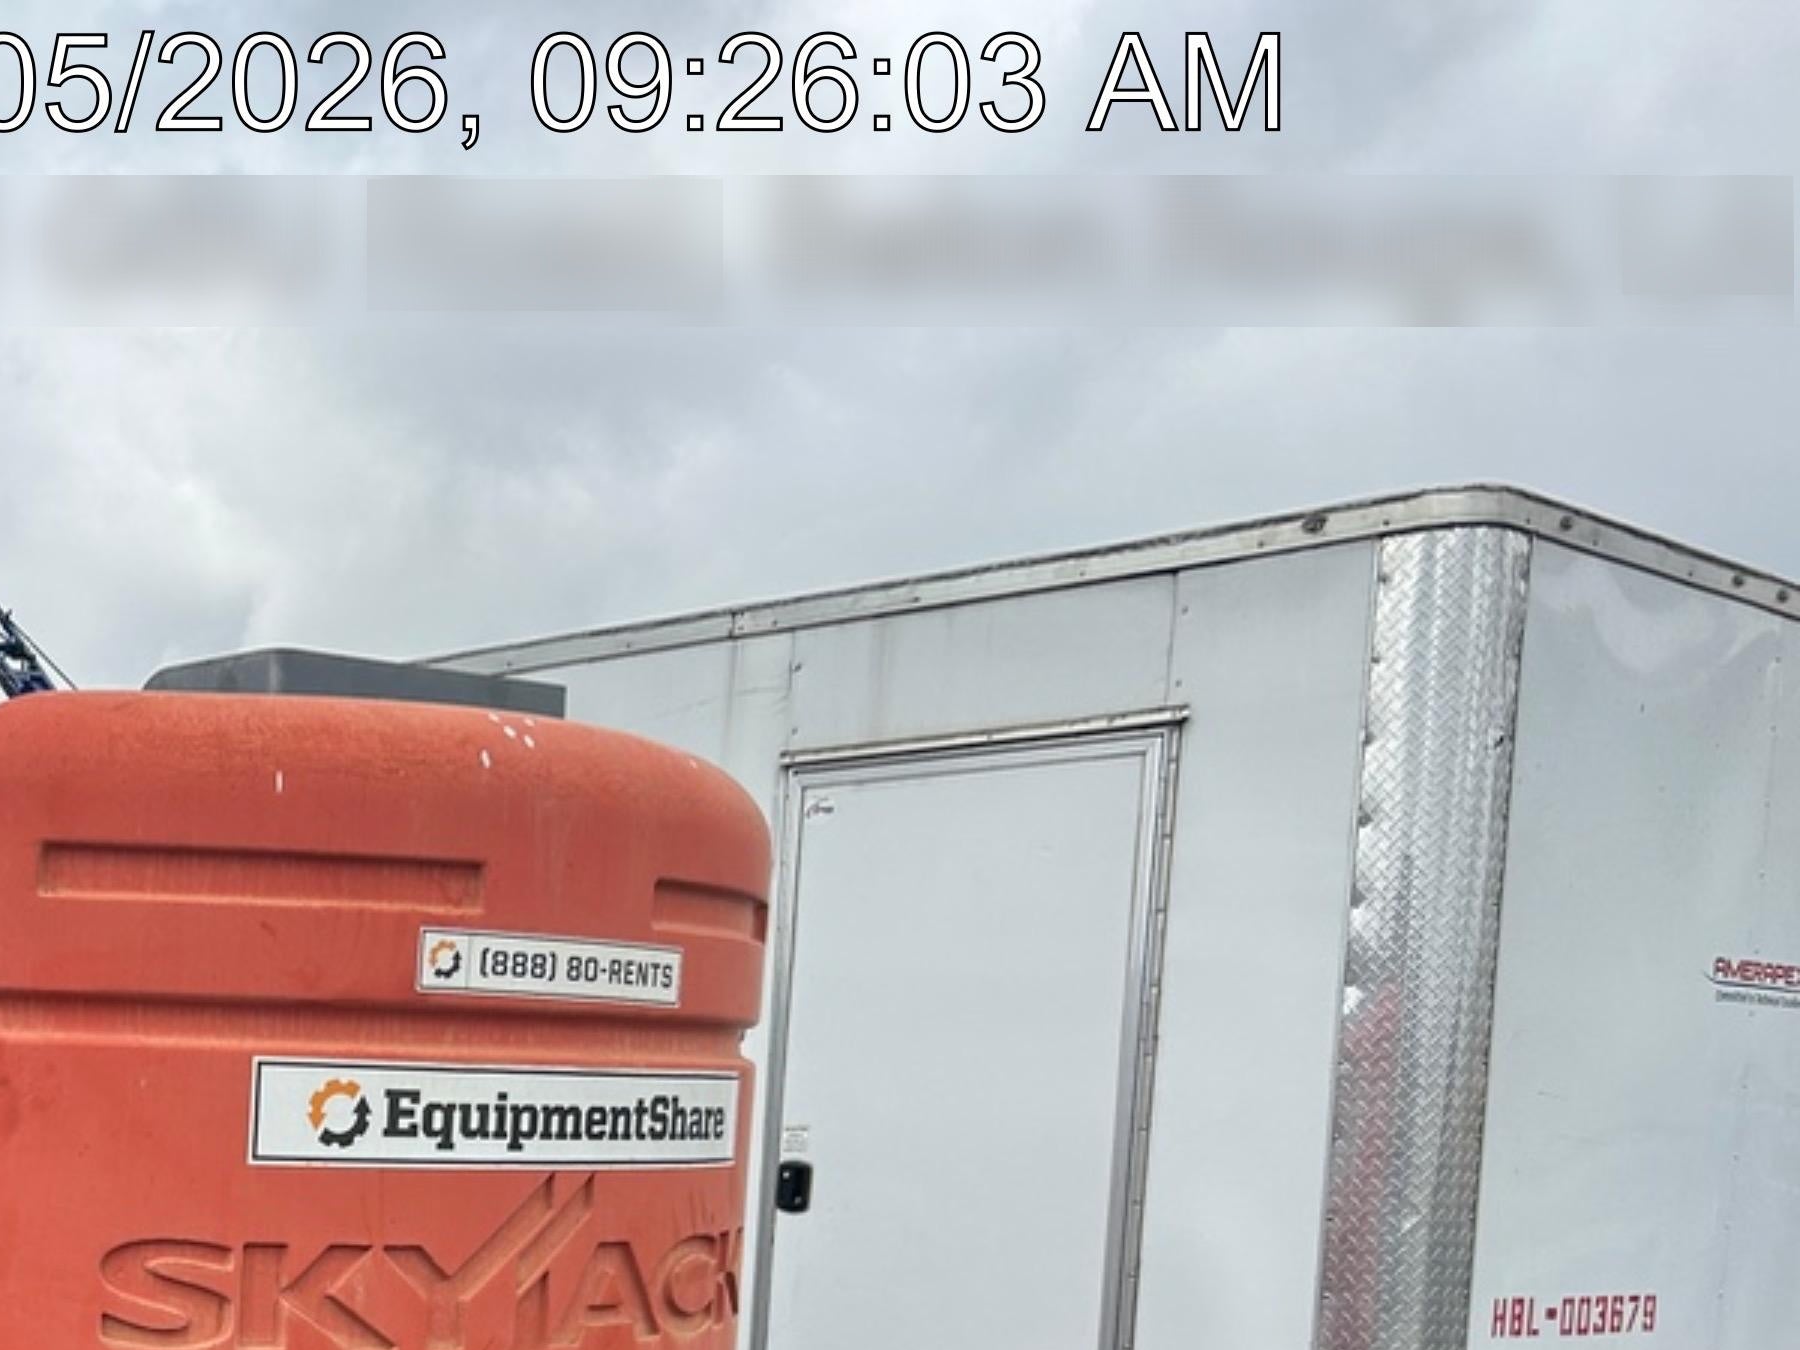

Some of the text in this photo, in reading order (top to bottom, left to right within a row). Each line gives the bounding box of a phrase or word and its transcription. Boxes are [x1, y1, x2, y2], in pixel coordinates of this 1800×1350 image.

[479, 947, 673, 989] (888) 80-RENTS
[383, 1088, 725, 1151] EquipmentShare
